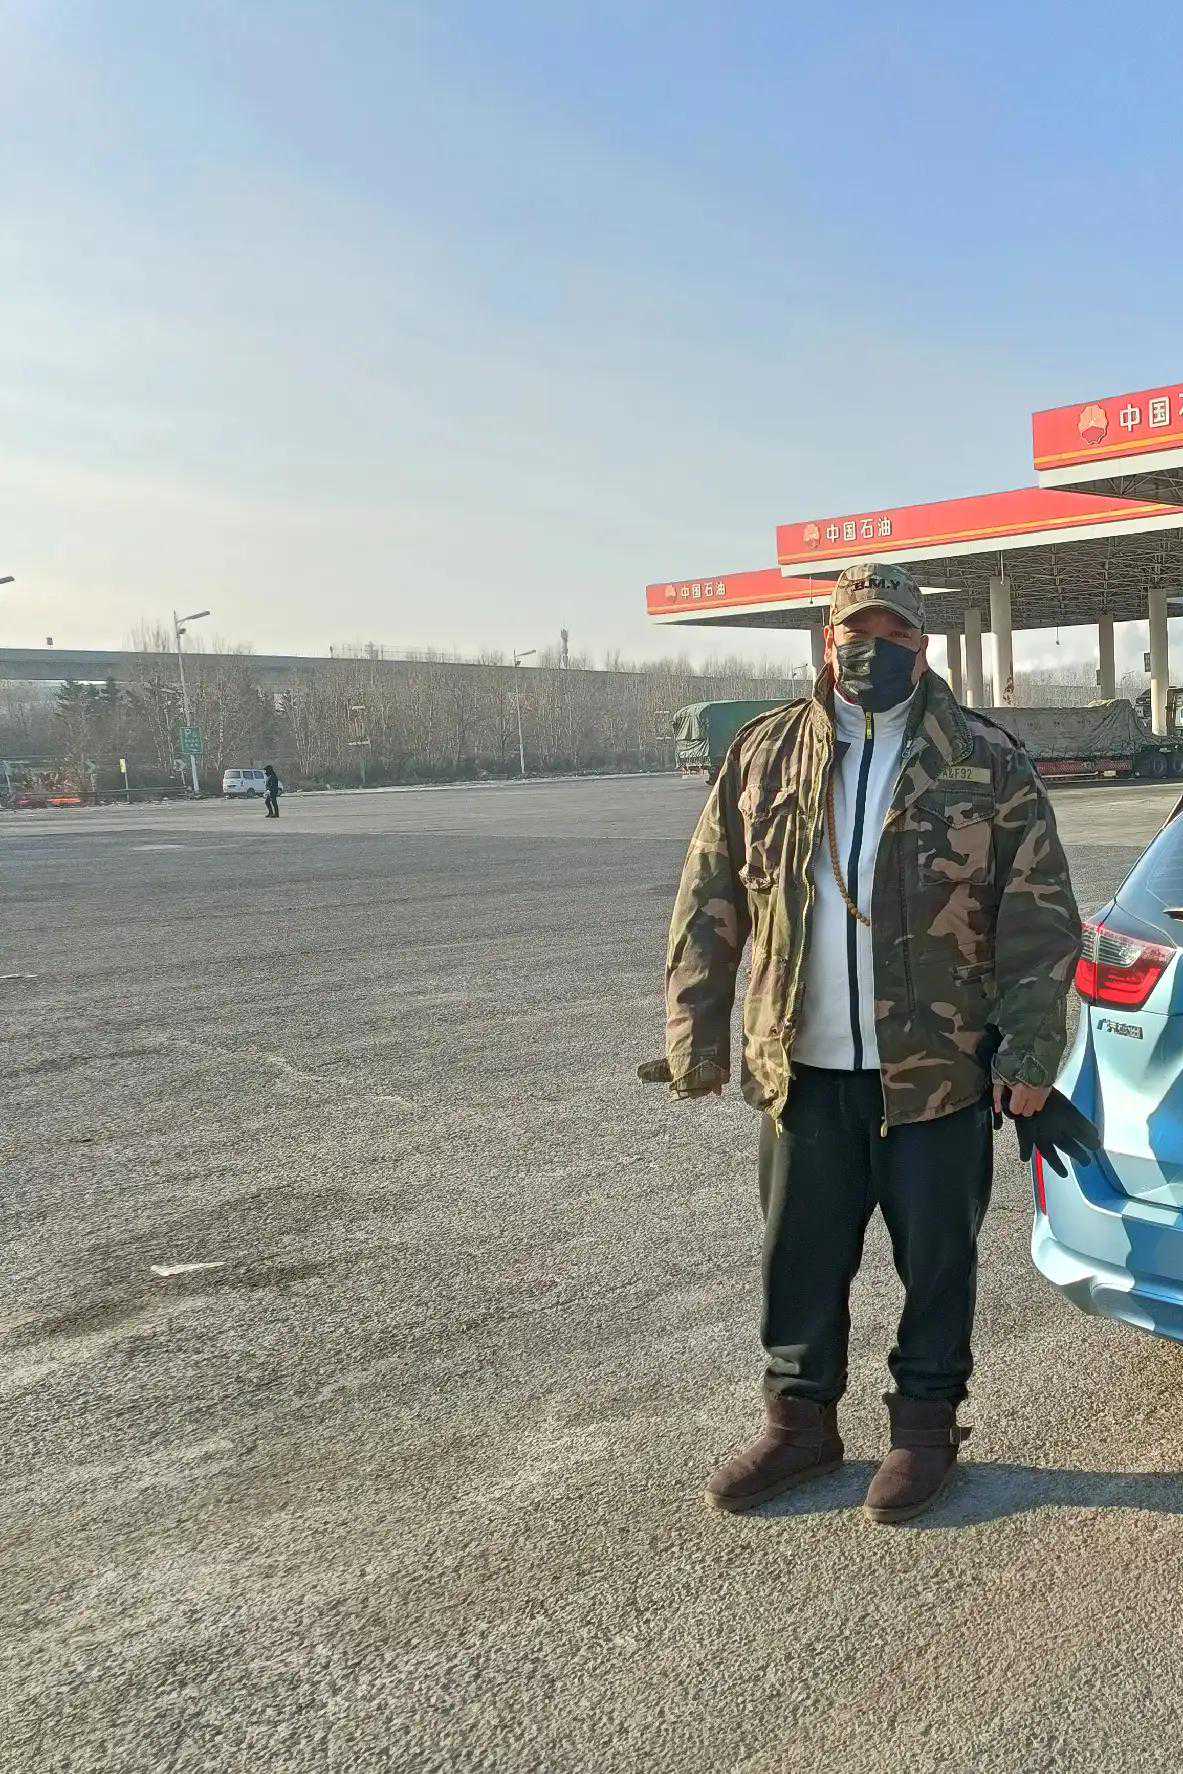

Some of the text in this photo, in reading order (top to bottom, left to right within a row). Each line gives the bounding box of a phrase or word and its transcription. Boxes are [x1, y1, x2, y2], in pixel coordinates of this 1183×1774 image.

[826, 516, 892, 543] 中国石油
[681, 582, 726, 599] 中国石油
